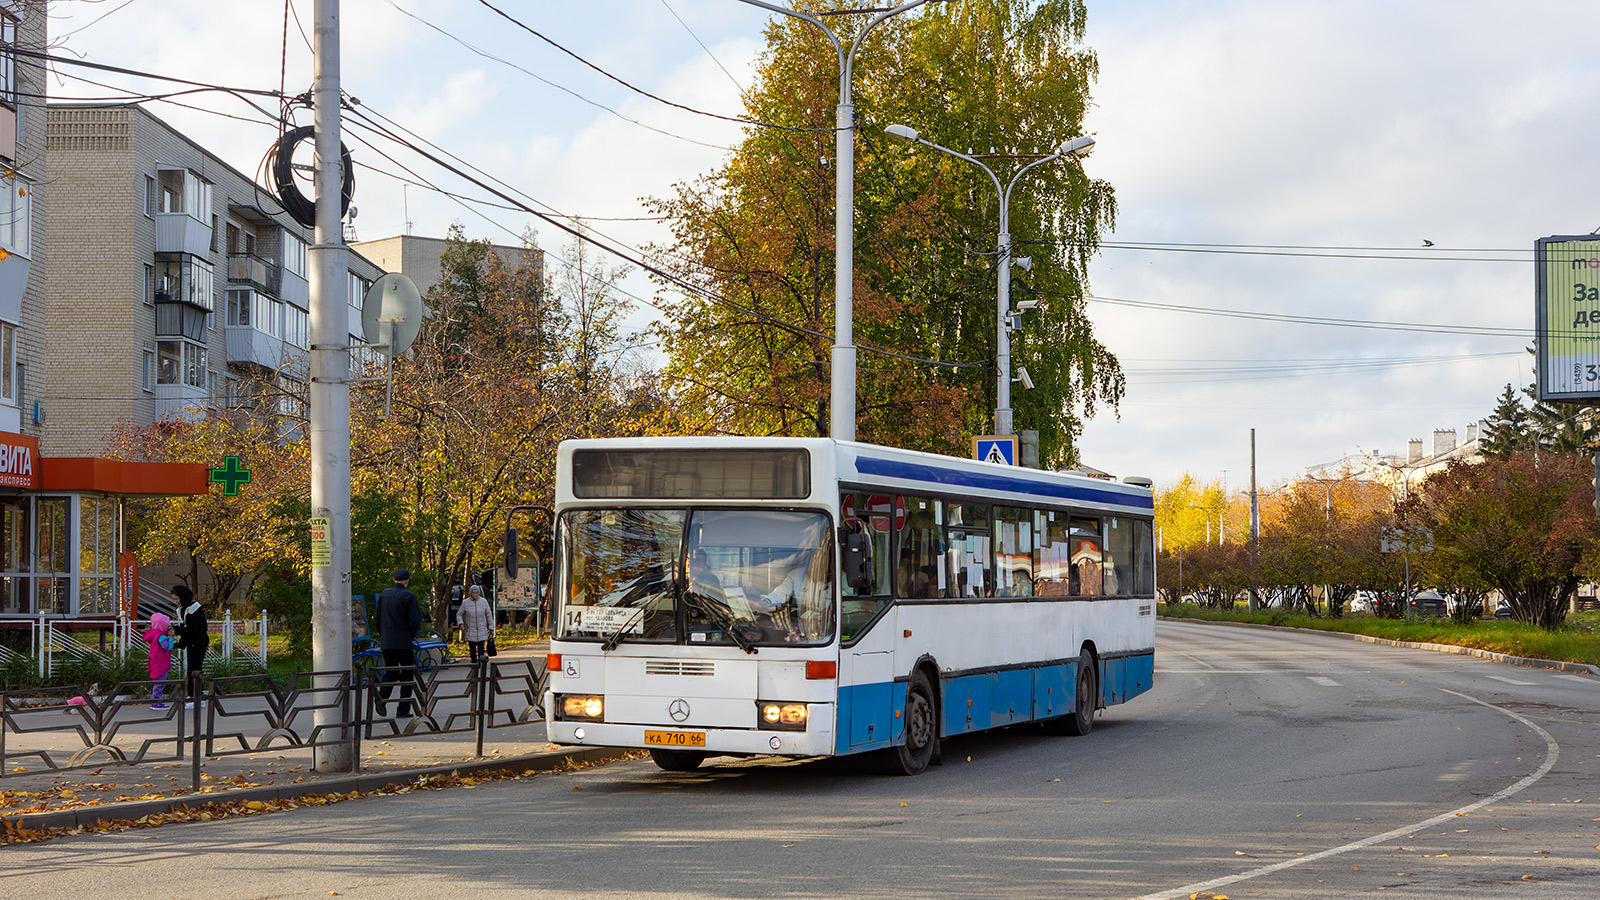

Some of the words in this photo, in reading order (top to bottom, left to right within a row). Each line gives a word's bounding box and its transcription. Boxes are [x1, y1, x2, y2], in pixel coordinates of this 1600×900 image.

[1573, 283, 1599, 301] За
[1573, 310, 1600, 328] де
[1585, 364, 1600, 382] 3
[0, 443, 32, 476] ВИТА
[0, 475, 32, 487] ЭКСПРЕСС
[567, 610, 582, 626] 14
[649, 735, 661, 743] КА
[666, 733, 685, 744] 710
[691, 733, 701, 742] 66
